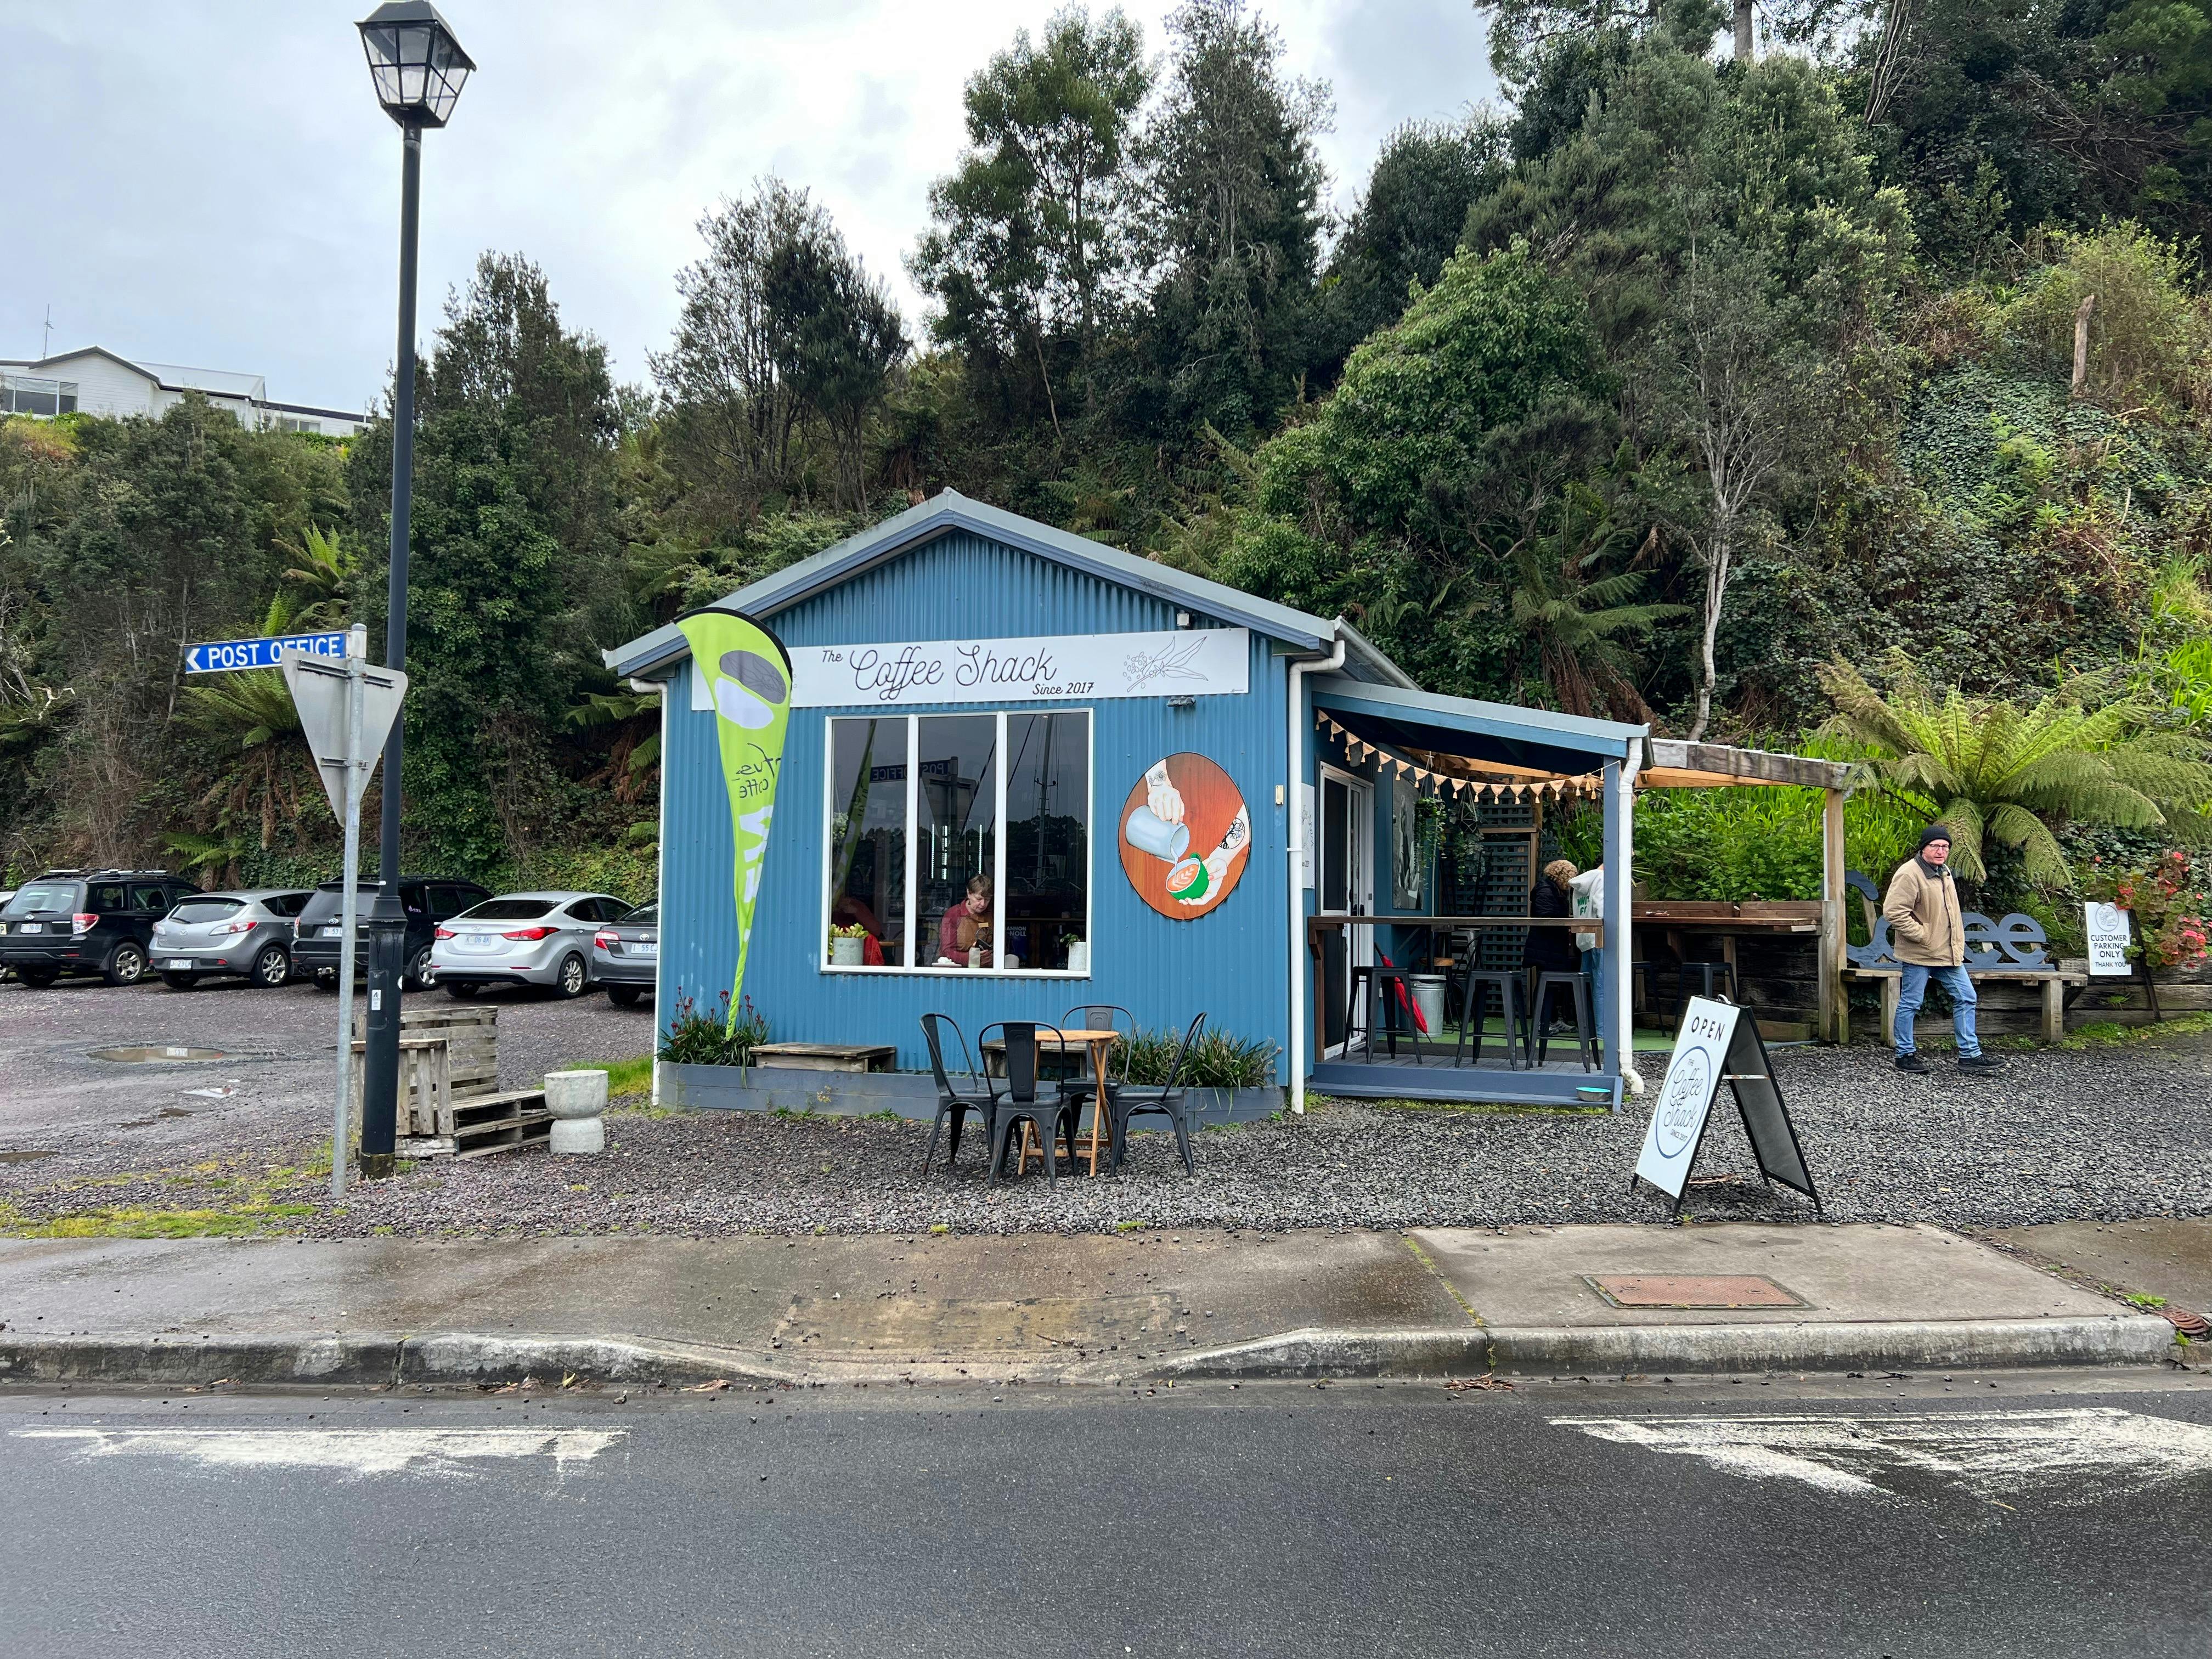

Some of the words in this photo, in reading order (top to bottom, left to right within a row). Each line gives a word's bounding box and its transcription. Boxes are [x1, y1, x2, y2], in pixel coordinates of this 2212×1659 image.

[208, 644, 260, 668] POST
[822, 650, 844, 663] The
[850, 646, 944, 700] Coffee
[956, 645, 1057, 686] Shack
[1032, 683, 1063, 695] Since
[1065, 682, 1094, 695] 2017
[1691, 1016, 1725, 1042] OPEN
[1671, 1068, 1703, 1106] Coffee
[1663, 1098, 1697, 1128] Shack
